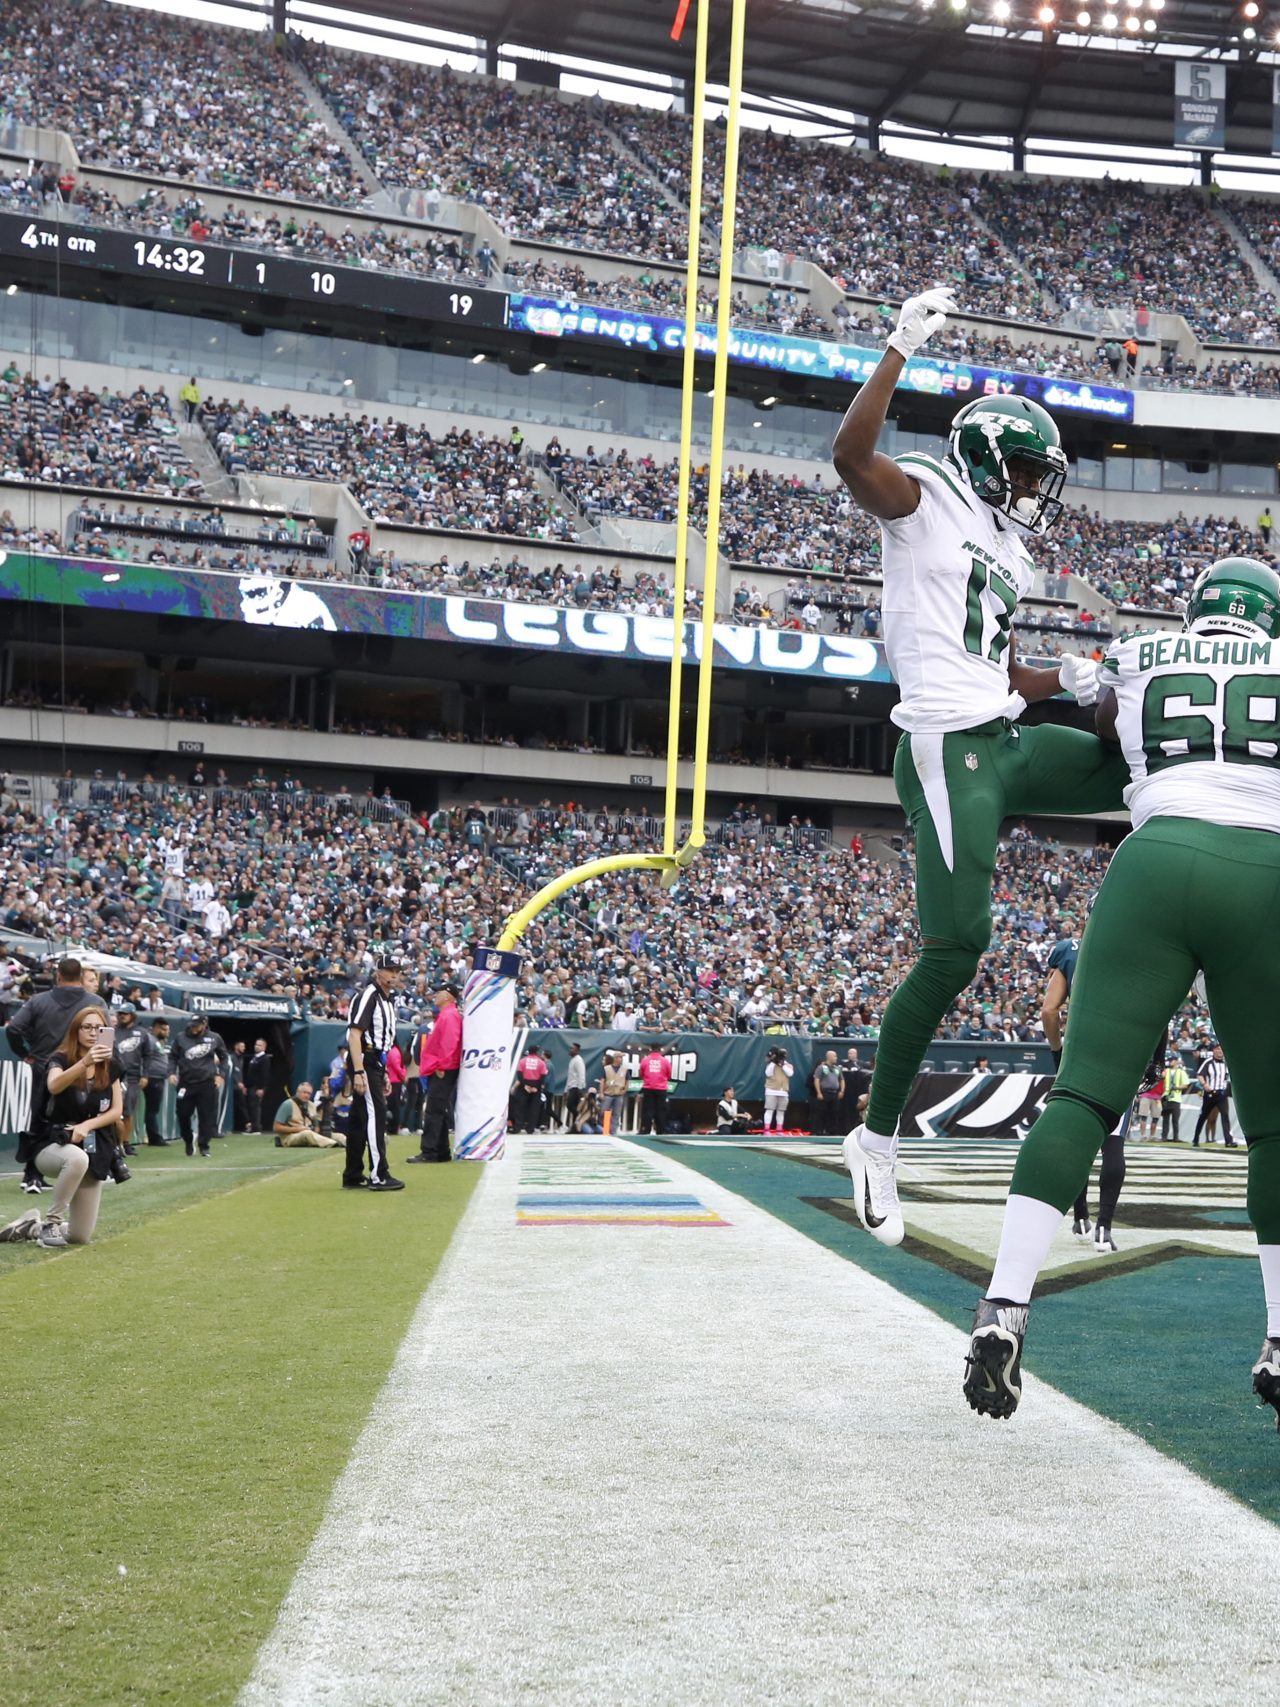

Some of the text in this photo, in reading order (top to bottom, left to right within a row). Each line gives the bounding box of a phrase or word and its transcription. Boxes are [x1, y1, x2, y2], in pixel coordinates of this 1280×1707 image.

[1190, 64, 1211, 100] 5
[20, 223, 96, 253] 4TH QTR
[134, 241, 205, 275] 14:32
[255, 262, 266, 285] 1
[311, 271, 336, 295] 10
[449, 293, 473, 316] 19
[984, 378, 1014, 395] BY
[1062, 393, 1128, 414] Santander
[961, 541, 997, 566] NEW
[1228, 602, 1246, 616] 68
[444, 597, 878, 677] LEGENDS
[1207, 619, 1258, 635] NEW YORK
[1139, 637, 1276, 672] BEACHUM
[633, 776, 650, 784] 105
[205, 998, 234, 1011] Lincoln
[234, 1000, 269, 1013] Financial
